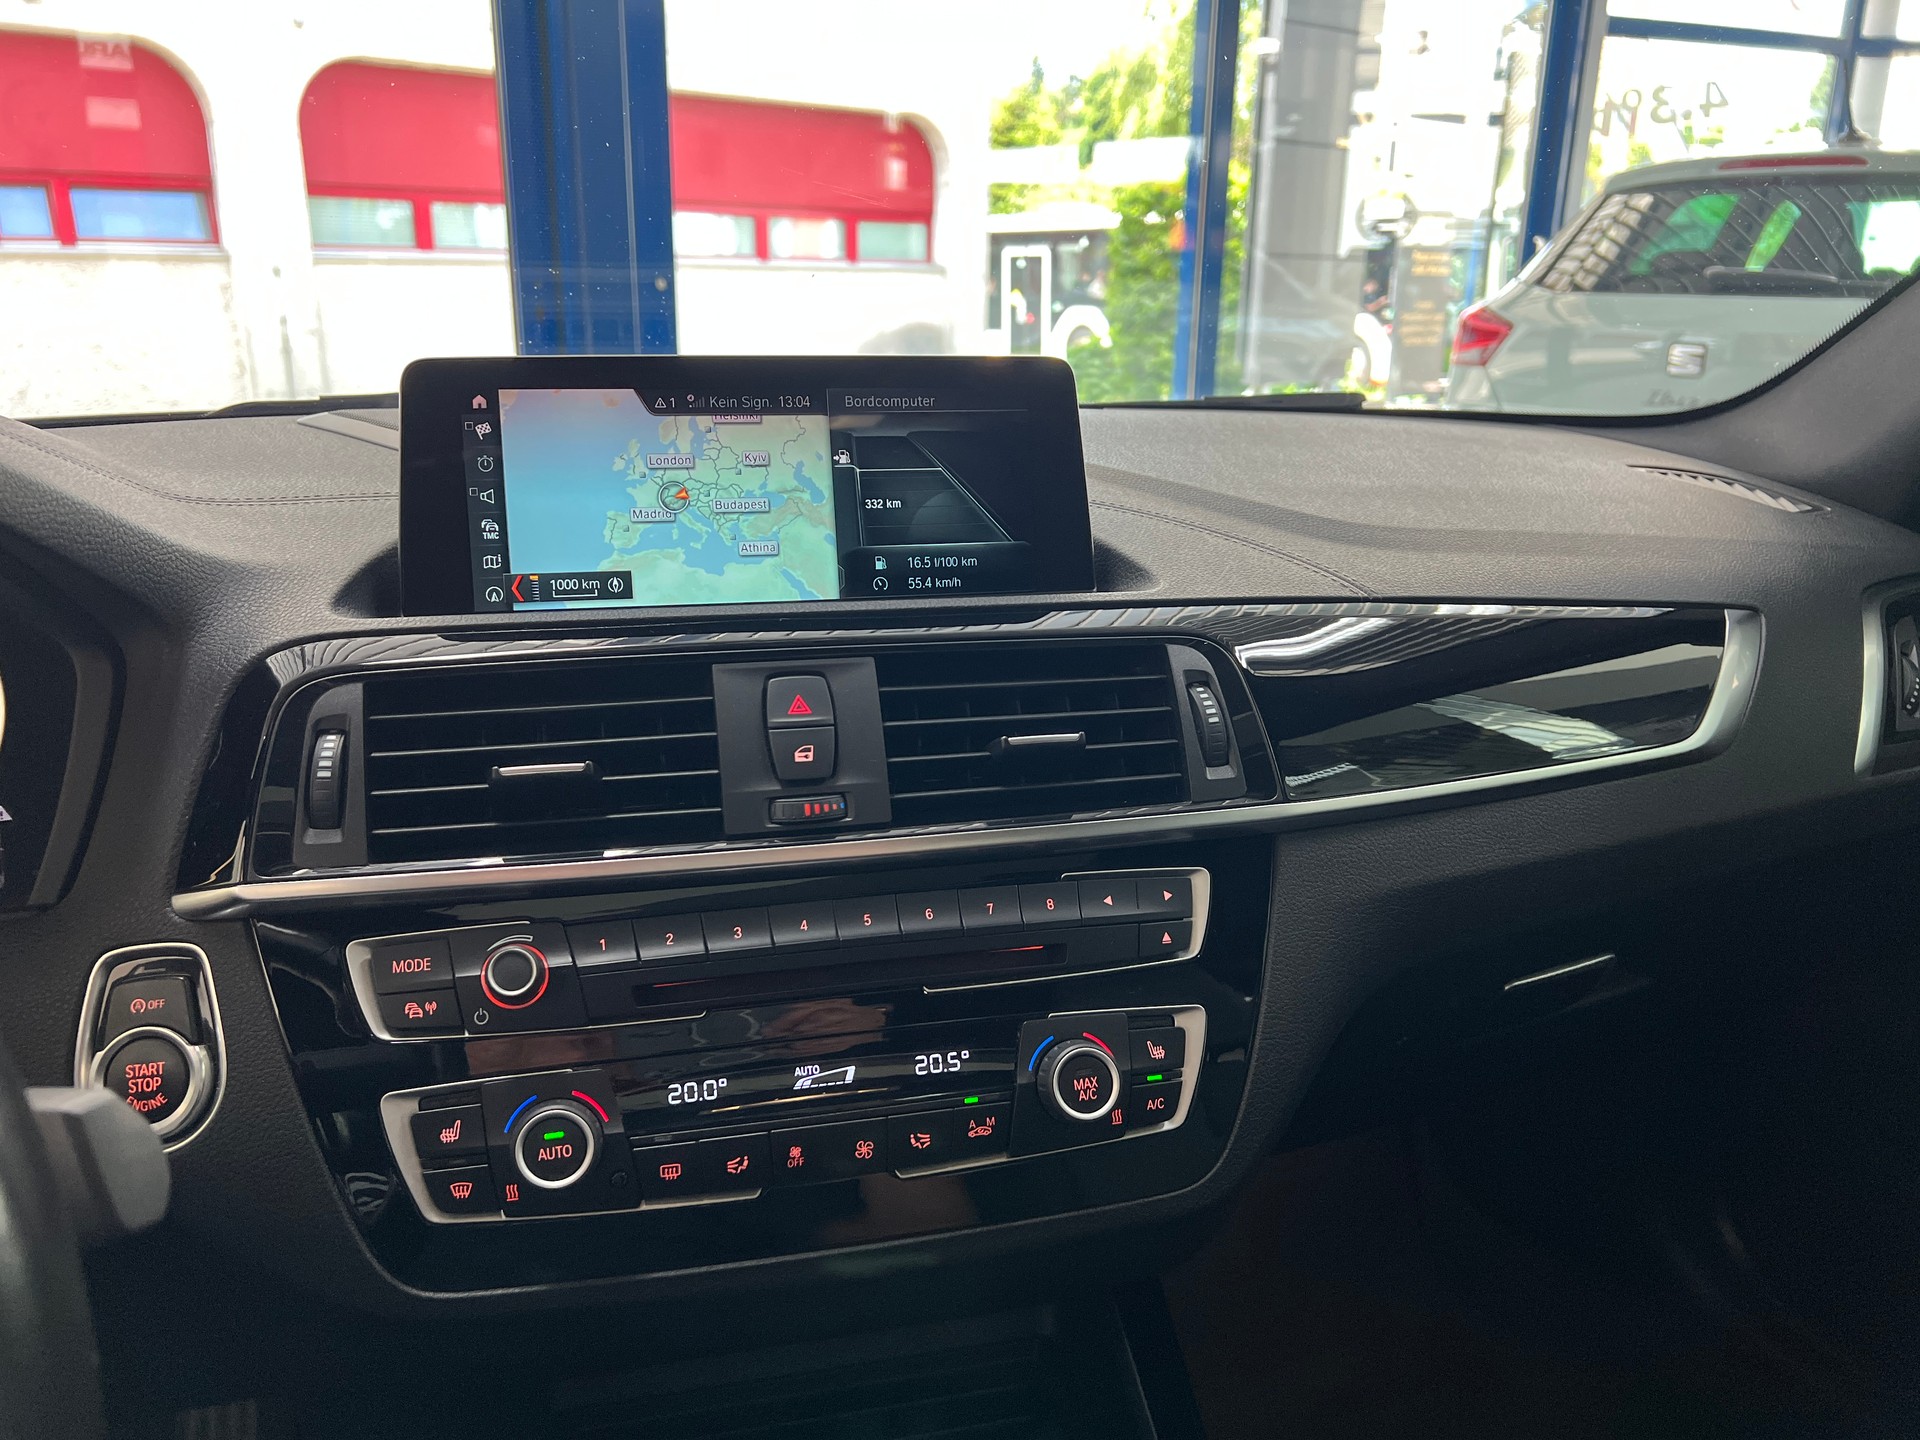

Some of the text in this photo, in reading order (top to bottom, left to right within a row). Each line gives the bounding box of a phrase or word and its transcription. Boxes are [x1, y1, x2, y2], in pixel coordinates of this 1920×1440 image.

[669, 397, 675, 408] 1
[709, 396, 811, 411] Kein Sign. 13:04
[844, 396, 936, 409] Bordcomputer
[649, 455, 692, 466] London
[744, 452, 767, 465] Kyiv
[715, 500, 768, 512] Budapest
[865, 499, 902, 509] 332 km
[632, 508, 672, 520] Madrid
[482, 531, 500, 540] TMC
[740, 543, 776, 553] Athina
[907, 556, 931, 569] 16.5
[961, 556, 978, 567] km
[550, 578, 601, 591] 1000 km
[908, 576, 962, 589] 55.4 km/h
[987, 902, 995, 915] 7
[1046, 897, 1054, 911] 8
[863, 913, 872, 926] 5
[925, 907, 934, 921] 6
[800, 919, 808, 931] 4
[665, 932, 674, 946] 2
[733, 926, 742, 939] 3
[600, 938, 607, 951] 1
[392, 957, 431, 974] MODE
[148, 999, 165, 1010] OFF
[125, 1062, 165, 1078] START
[794, 1065, 820, 1075] AUTO
[128, 1077, 161, 1094] STOP
[1074, 1077, 1098, 1091] MAX
[1078, 1088, 1097, 1101] A/C
[126, 1092, 168, 1112] ENGINE
[1146, 1097, 1165, 1110] A/C
[538, 1144, 573, 1161] AUTO
[787, 1156, 805, 1167] OFF
